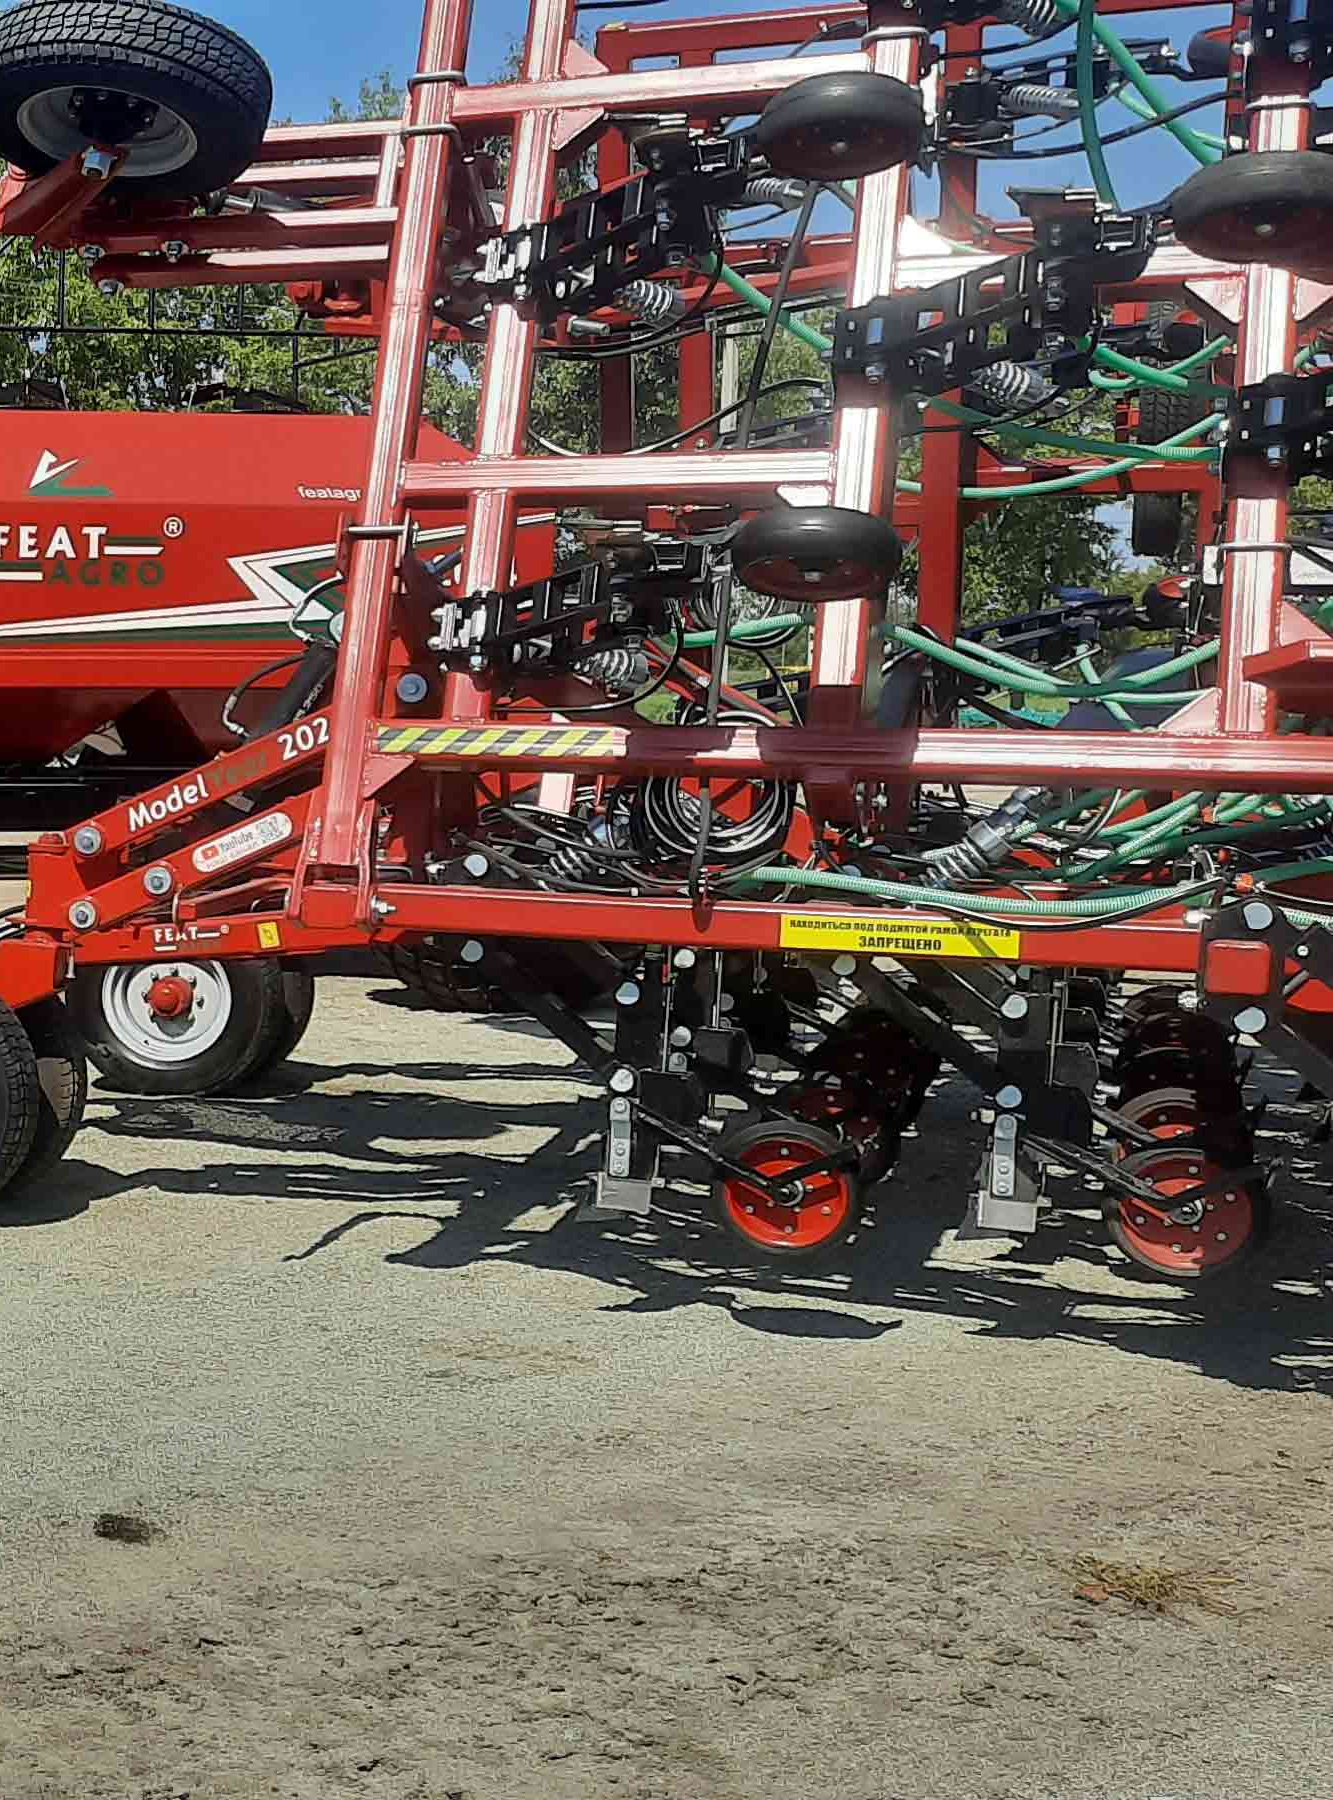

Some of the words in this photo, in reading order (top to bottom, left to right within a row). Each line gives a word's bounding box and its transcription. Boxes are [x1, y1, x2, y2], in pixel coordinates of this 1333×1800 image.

[296, 483, 362, 502] featagr
[48, 560, 166, 587] AGRO
[128, 773, 209, 832] Model
[276, 716, 330, 761] 202
[853, 922, 874, 932] ПОД
[858, 935, 942, 951] ЗАПРЕЩЕНО
